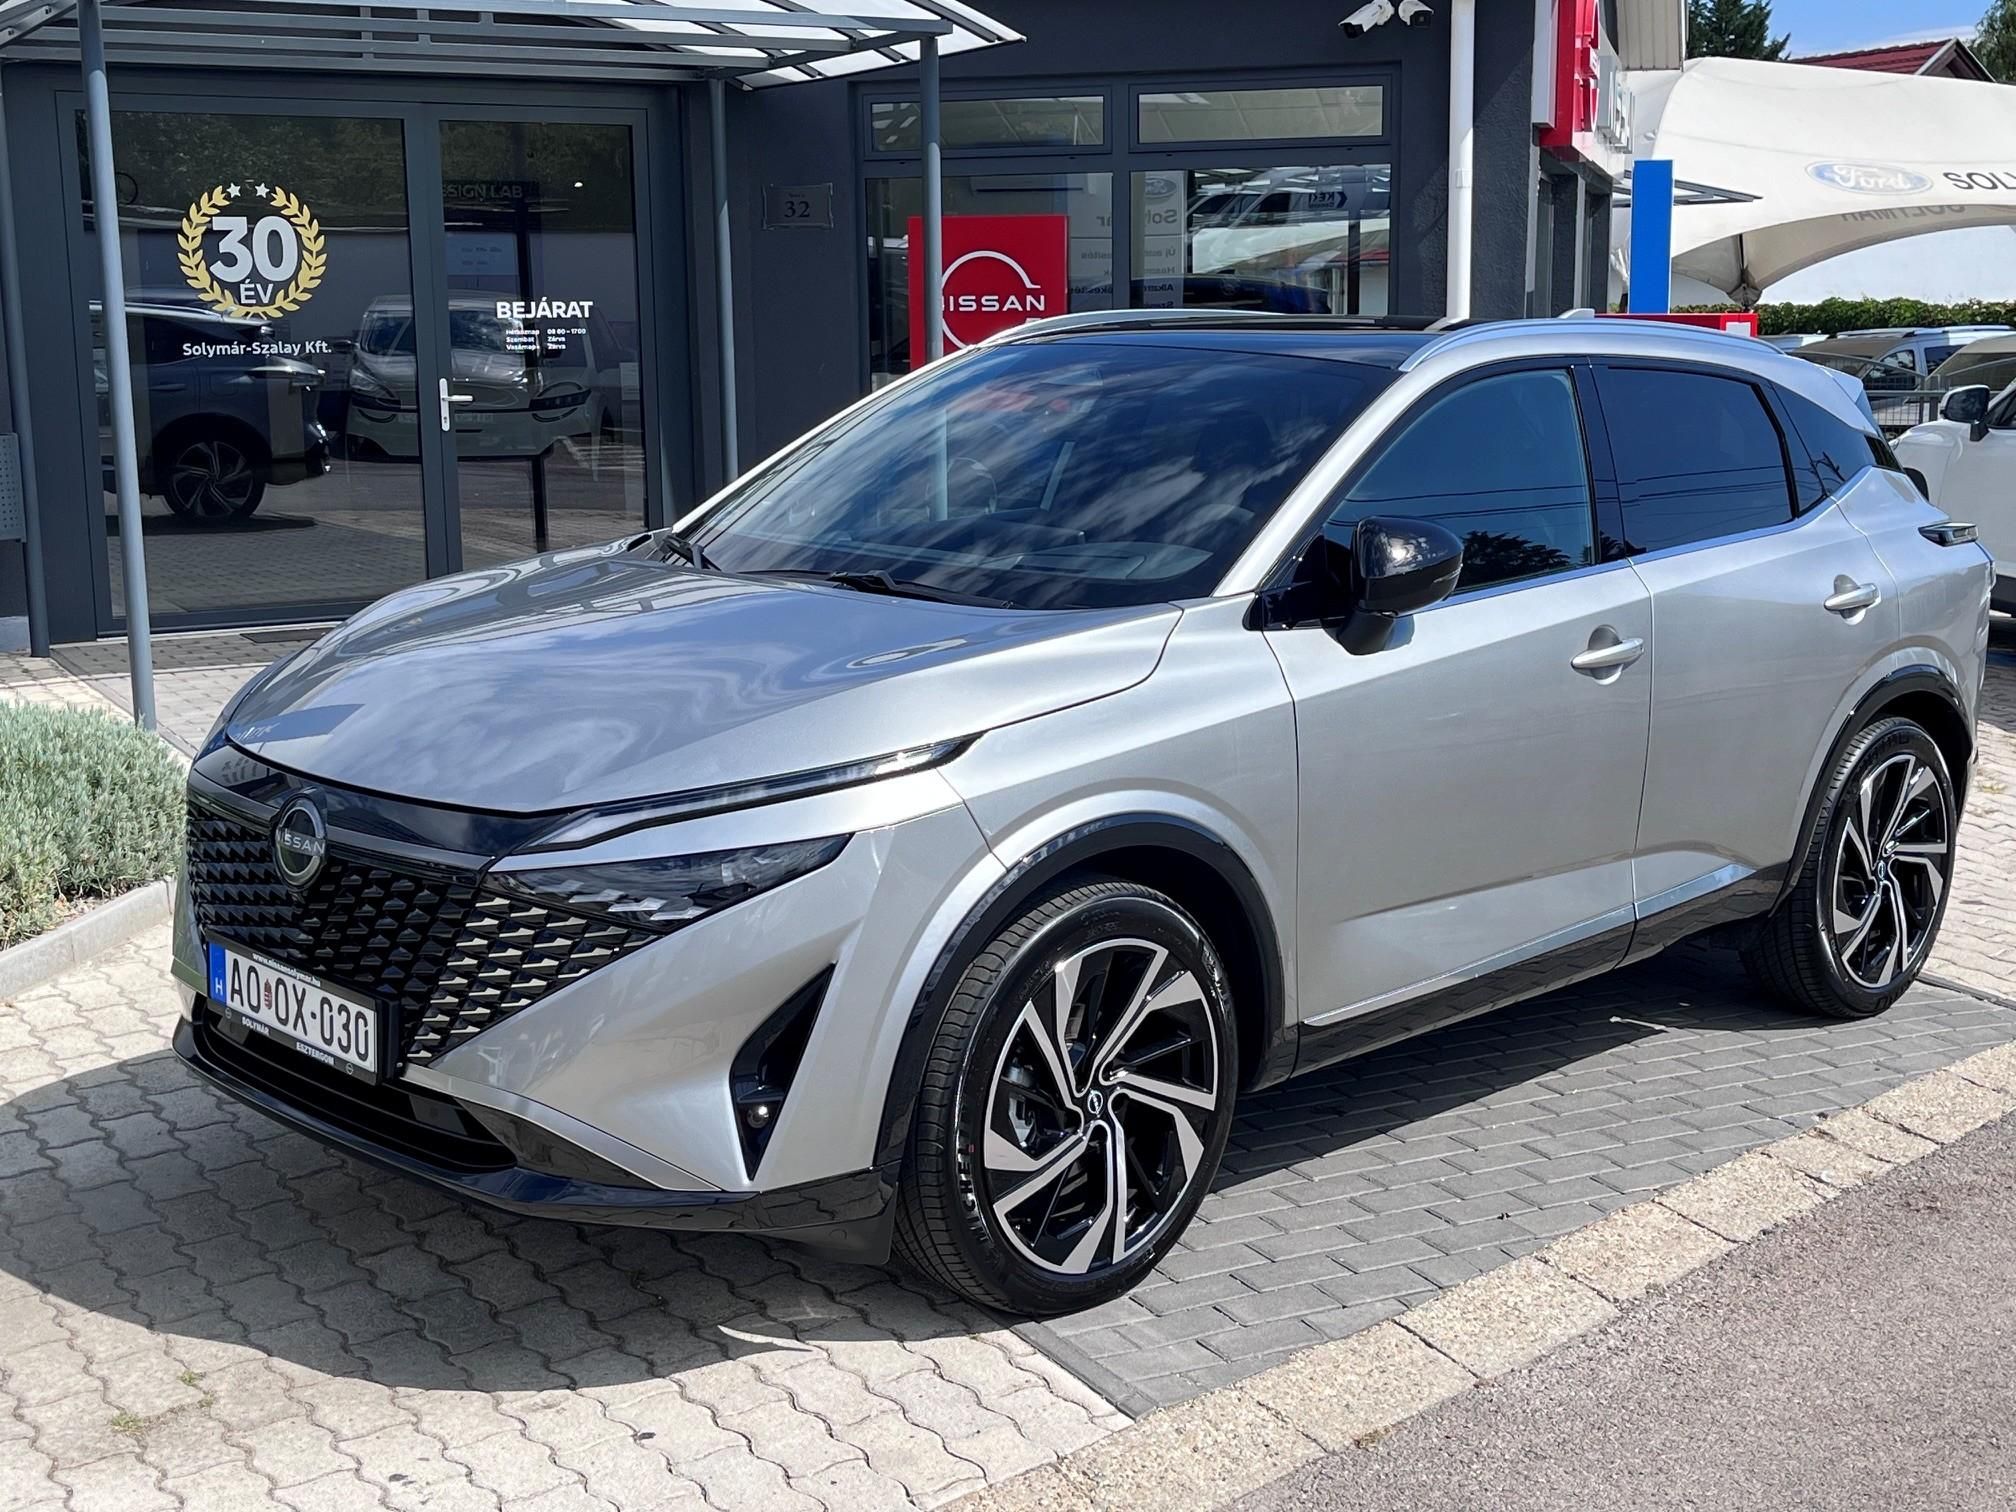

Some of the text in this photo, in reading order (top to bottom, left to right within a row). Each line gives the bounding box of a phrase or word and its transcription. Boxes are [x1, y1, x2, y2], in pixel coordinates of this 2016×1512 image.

[1833, 164, 1911, 190] Ford
[491, 185, 523, 198] LAB
[784, 200, 810, 218] 32
[209, 215, 299, 283] 30
[239, 279, 274, 304] ÉV
[496, 296, 594, 319] BEJÁRAT
[942, 294, 1045, 312] ISSAN
[182, 340, 332, 356] Solymár-Szalay Kft.
[215, 978, 224, 995] H
[296, 1042, 335, 1065] ESZTERGOM
